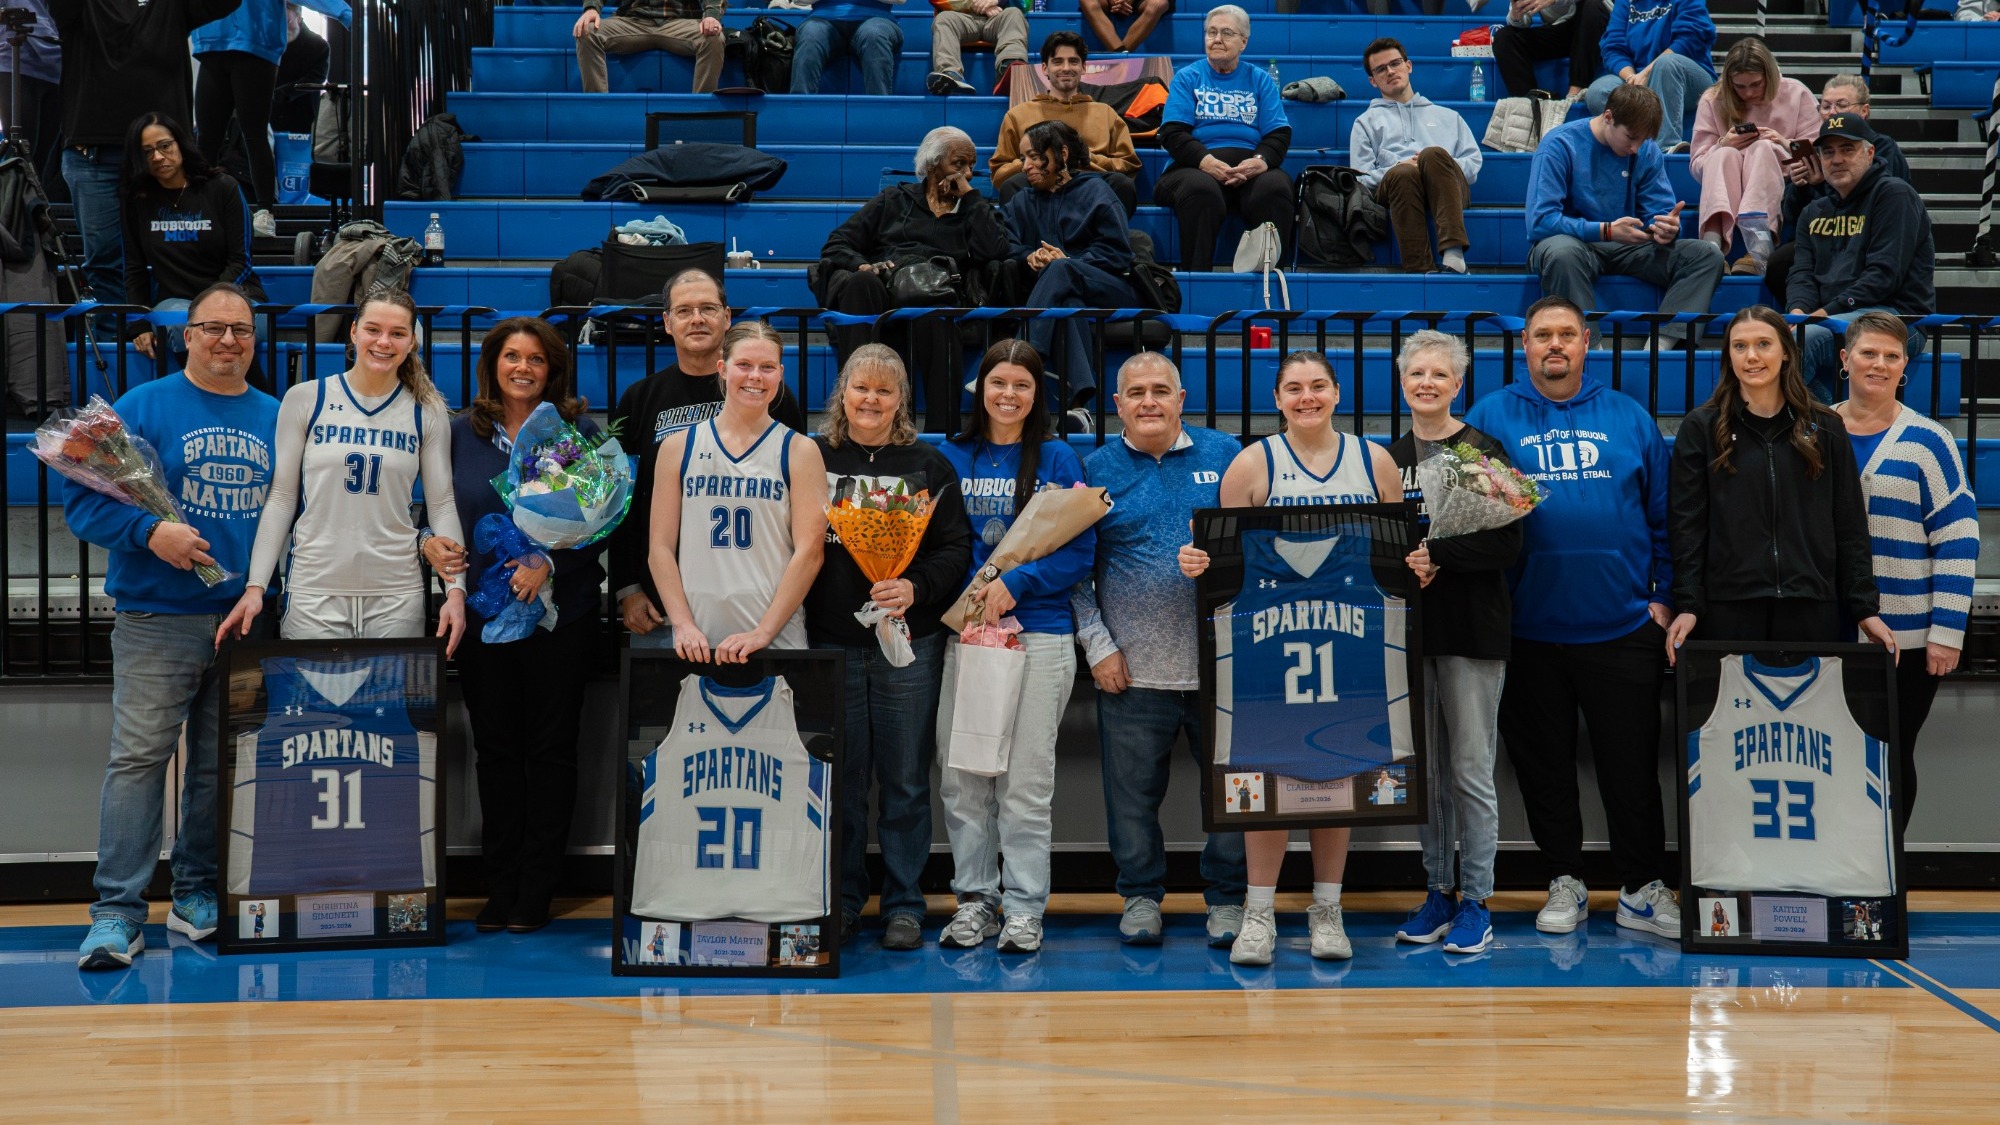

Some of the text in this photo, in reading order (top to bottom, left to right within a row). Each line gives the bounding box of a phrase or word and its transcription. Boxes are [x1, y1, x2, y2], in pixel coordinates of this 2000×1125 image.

[1194, 88, 1256, 107] HOOPS
[1195, 101, 1240, 118] CLUB
[1828, 118, 1844, 129] M
[151, 220, 212, 231] DUBUQUE
[164, 230, 199, 242] MOM
[181, 427, 225, 441] UNIVERSITY
[238, 430, 269, 449] DUBUQUE
[313, 423, 418, 455] SPARTANS
[1560, 430, 1571, 439] OF
[183, 434, 270, 471] SPARTANS
[208, 465, 246, 482] 1960
[343, 451, 384, 495] 31
[1192, 470, 1220, 485] UD
[1562, 470, 1612, 480] BASETBALL
[181, 476, 269, 512] NATION
[686, 474, 785, 502] SPARTANS
[710, 504, 754, 550] 20
[1253, 600, 1365, 644] SPARTANS
[1284, 640, 1339, 704] 21
[282, 729, 394, 769] SPARTANS
[1734, 721, 1832, 776] SPARTANS
[683, 746, 783, 803] SPARTANS
[312, 769, 366, 830] 31
[1747, 778, 1818, 841] 33
[695, 806, 763, 870] 20
[312, 902, 359, 911] CHRISTINA
[312, 911, 359, 920] SIMONETTI
[1772, 905, 1807, 914] KAITLYN
[320, 922, 352, 930] 2021-2026
[1773, 914, 1807, 924] POWELL
[696, 934, 763, 946] TAYLOR MARTIN
